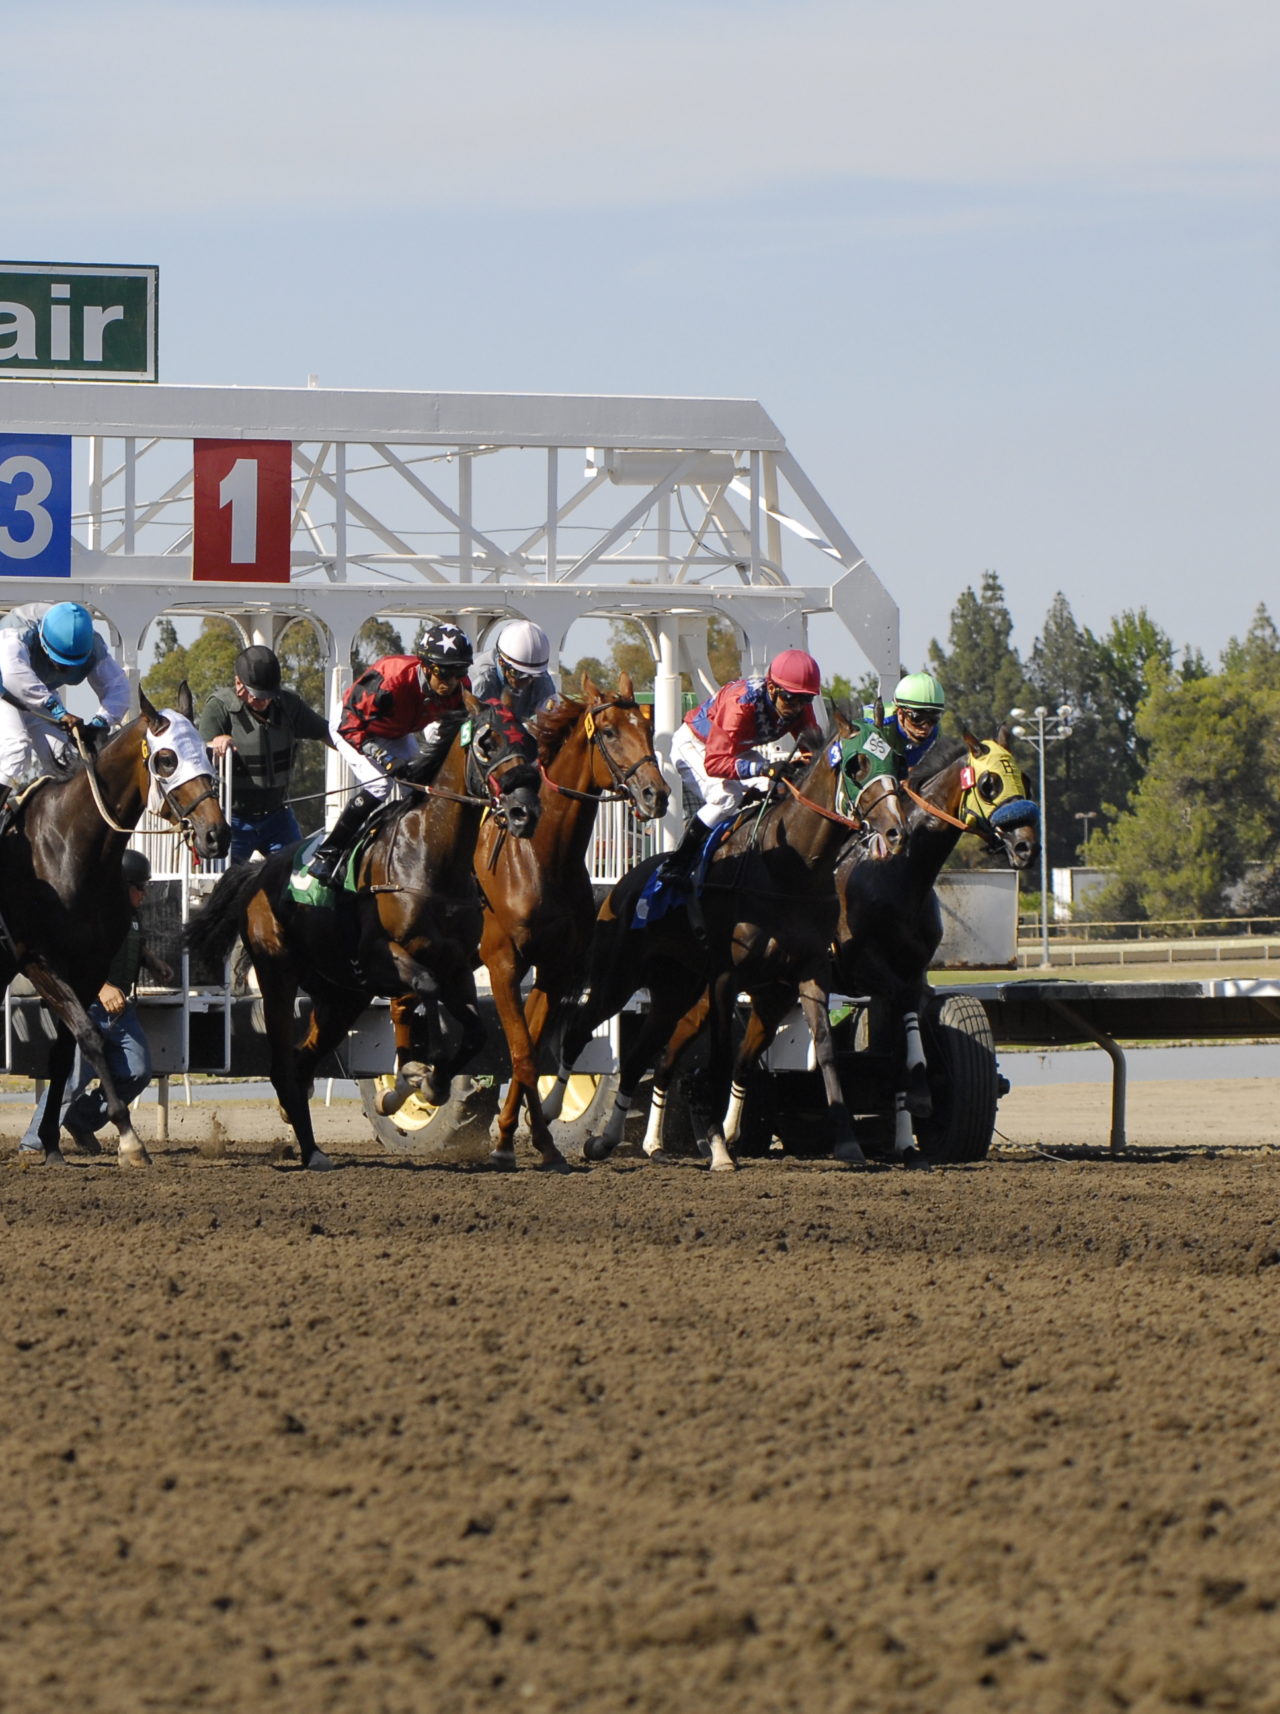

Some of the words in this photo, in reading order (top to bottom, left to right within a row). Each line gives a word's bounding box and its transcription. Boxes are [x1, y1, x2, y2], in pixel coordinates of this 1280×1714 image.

[219, 458, 258, 564] 1
[829, 745, 842, 763] 3
[963, 767, 973, 785] 1
